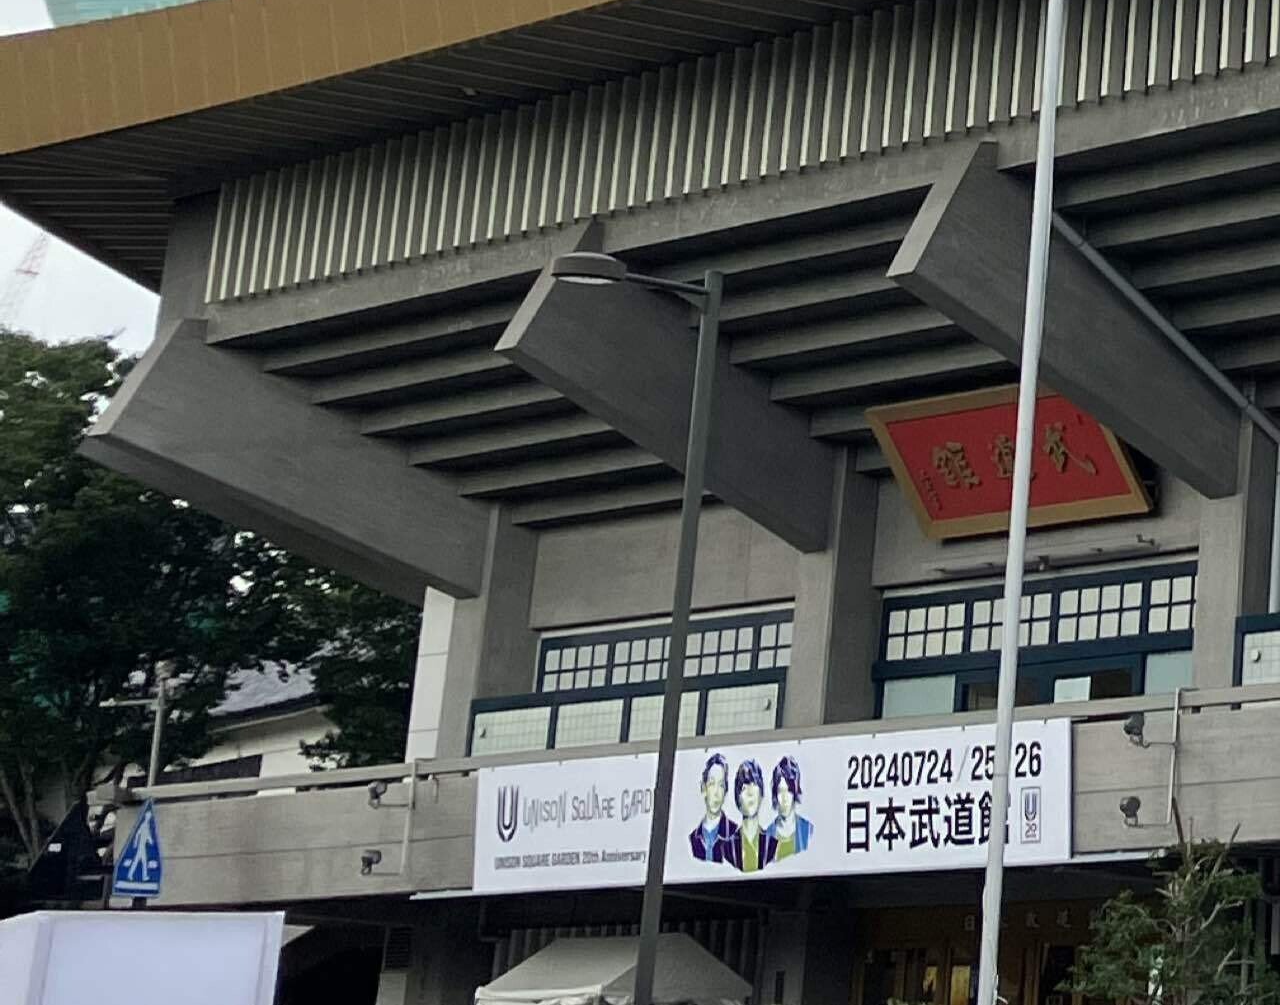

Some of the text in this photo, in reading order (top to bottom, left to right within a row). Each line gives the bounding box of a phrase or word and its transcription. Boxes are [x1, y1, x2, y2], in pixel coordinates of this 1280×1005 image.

[847, 748, 953, 790] 20240724
[1015, 741, 1041, 778] 26
[601, 849, 646, 864] Anniversary
